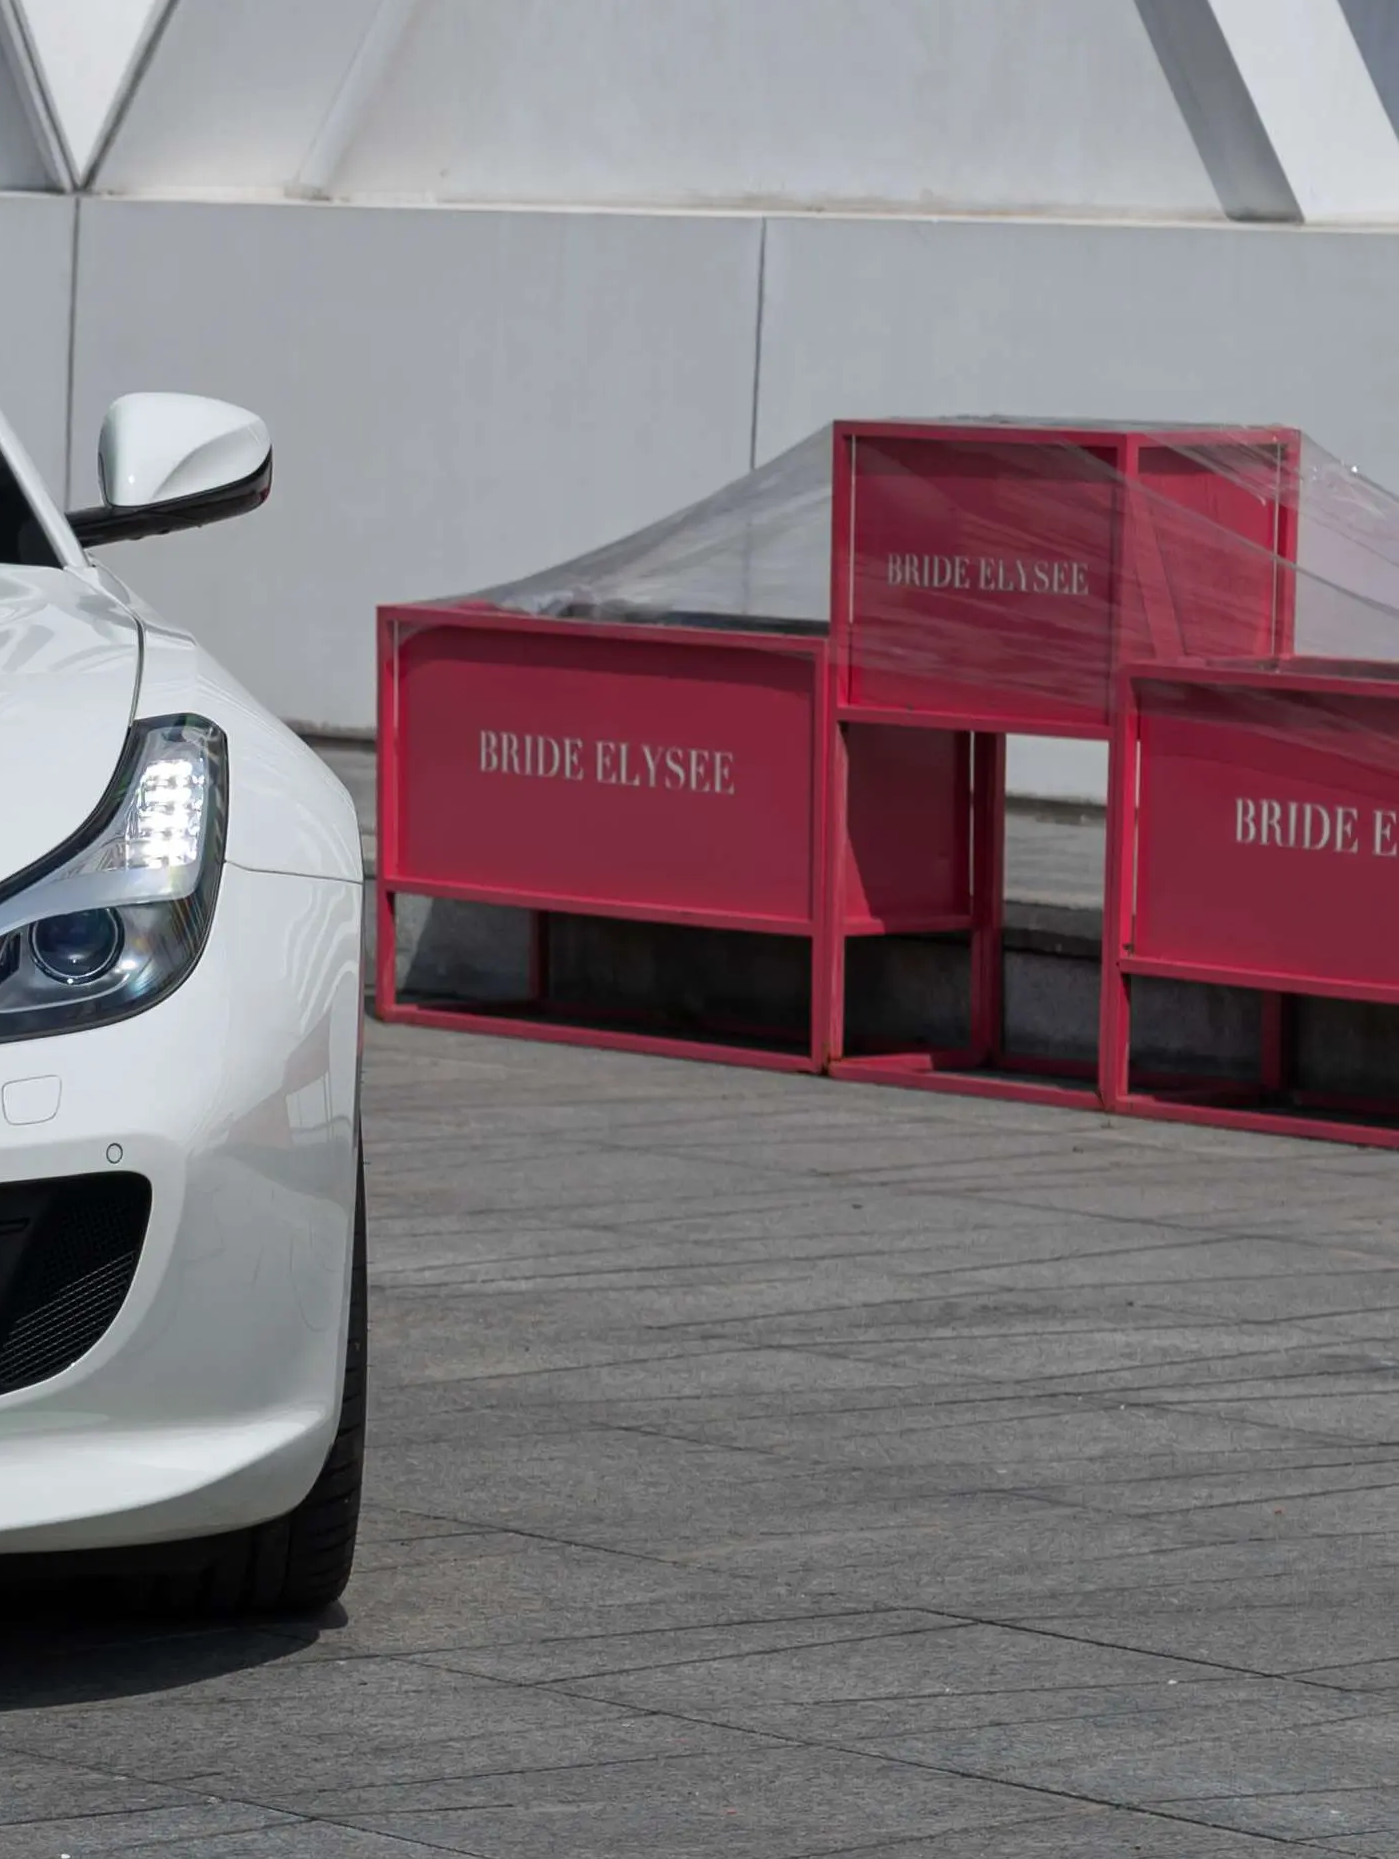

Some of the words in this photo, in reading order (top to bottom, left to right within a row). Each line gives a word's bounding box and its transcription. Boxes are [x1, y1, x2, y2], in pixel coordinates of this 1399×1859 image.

[887, 552, 971, 590] BRIDE
[979, 557, 1089, 596] ELYSEE
[480, 730, 584, 781] BRIDE
[596, 741, 735, 794] ELYSEE
[1235, 797, 1358, 854] BRIDE
